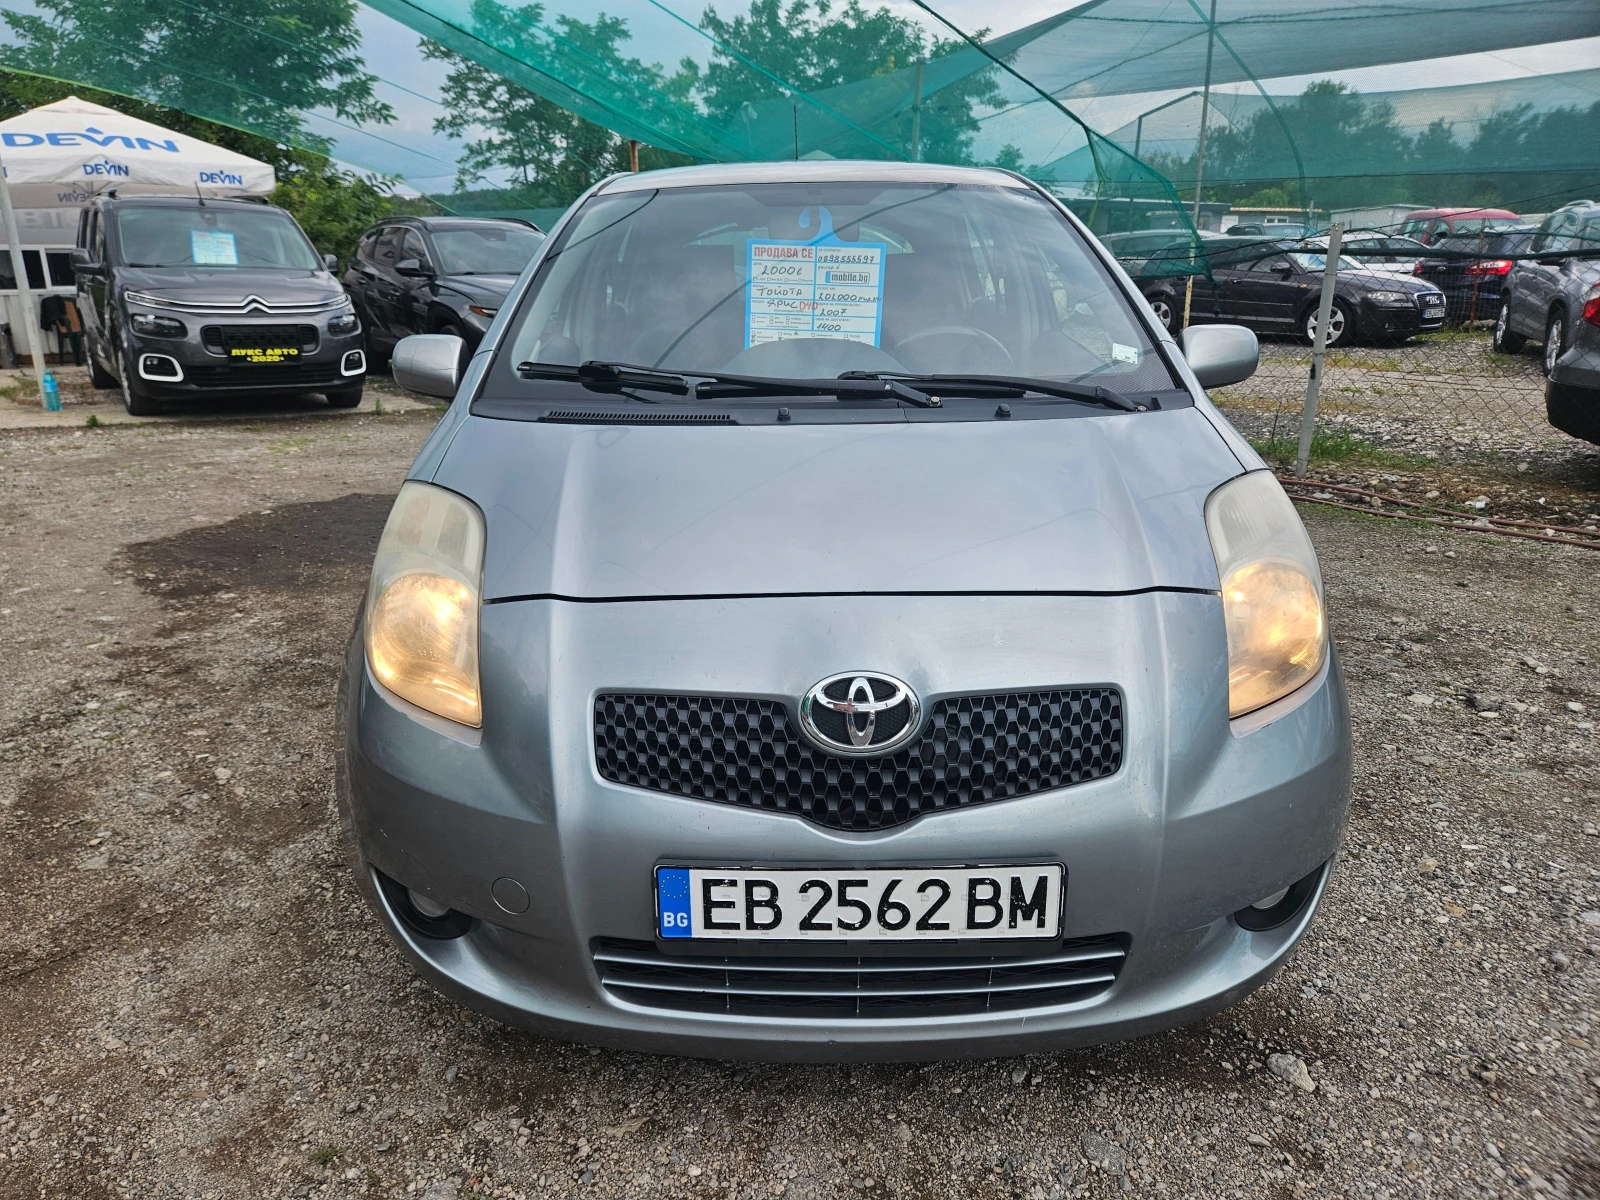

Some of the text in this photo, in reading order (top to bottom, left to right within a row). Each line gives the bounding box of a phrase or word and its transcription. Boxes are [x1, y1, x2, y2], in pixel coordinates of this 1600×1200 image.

[1, 128, 180, 153] DEVIN
[83, 160, 130, 177] DEVIN
[199, 170, 243, 186] DEVIN
[754, 247, 813, 259] ПРОДАВА СЕ
[831, 272, 869, 284] mobile.bg
[819, 308, 848, 317] 2007
[816, 322, 842, 332] 1400
[231, 348, 299, 356] ЛУКС АВТО
[251, 355, 280, 363] 2020
[702, 874, 1048, 931] EB 2562 BM
[662, 911, 688, 928] BG
